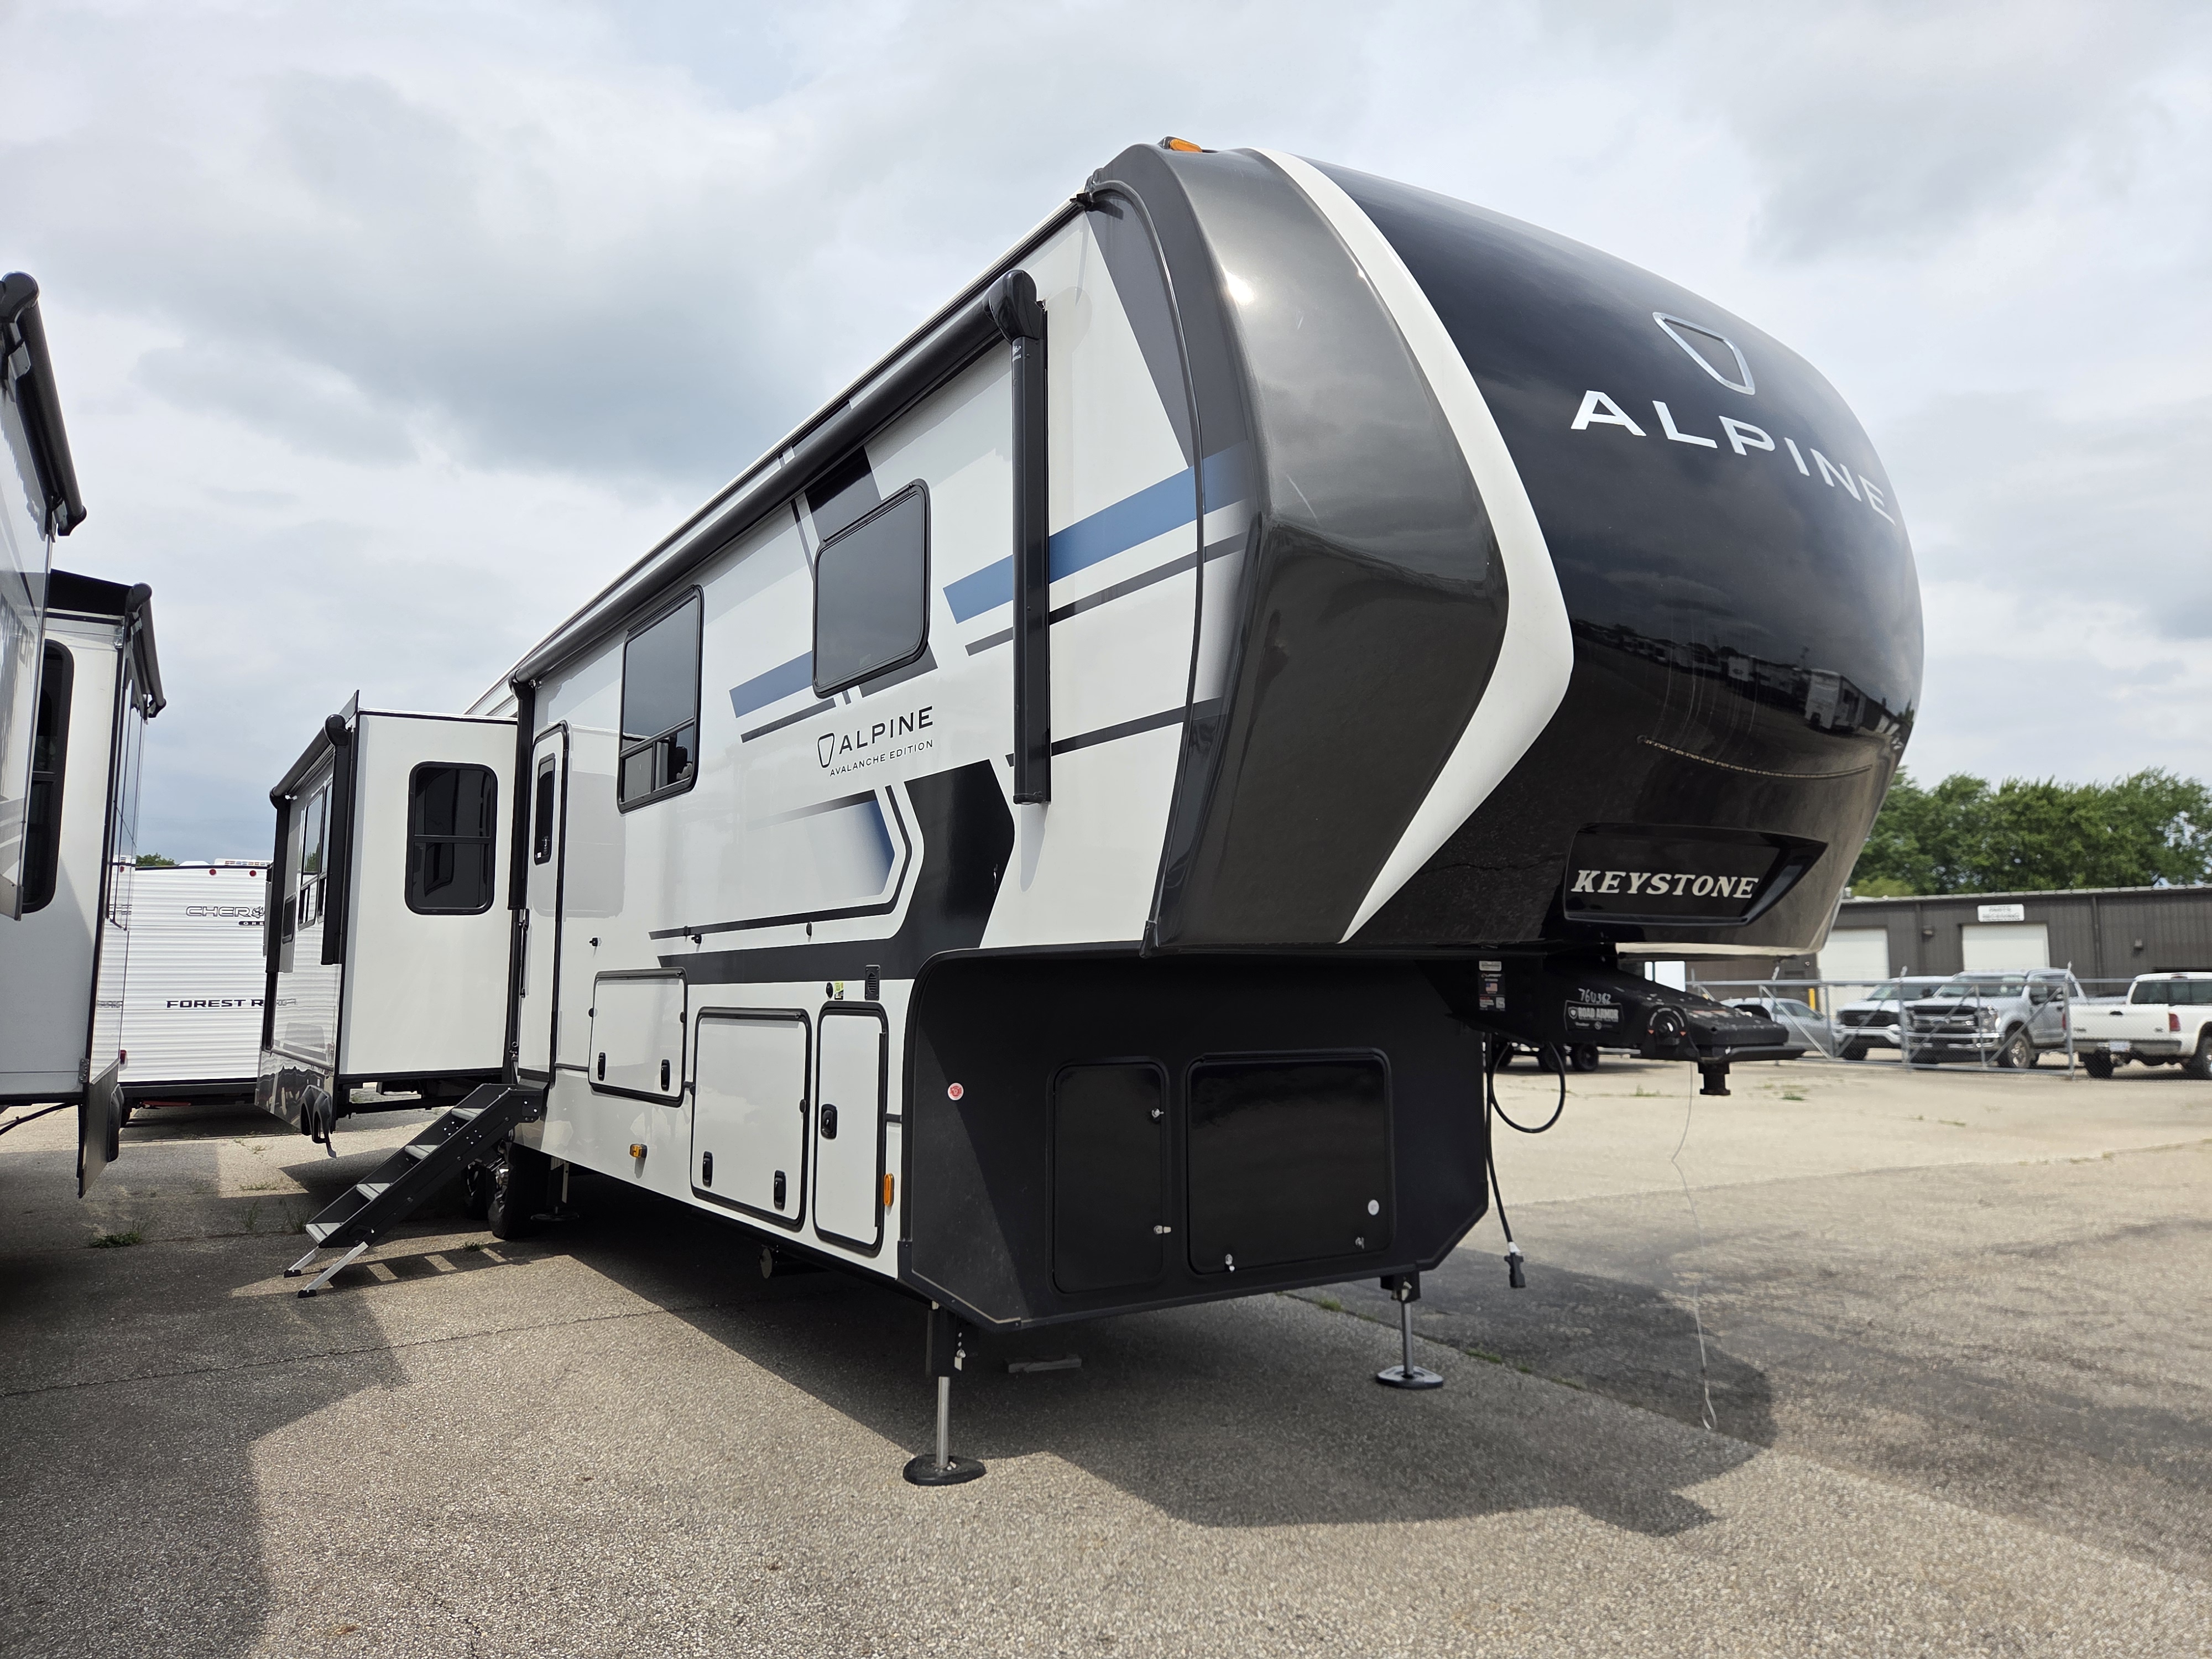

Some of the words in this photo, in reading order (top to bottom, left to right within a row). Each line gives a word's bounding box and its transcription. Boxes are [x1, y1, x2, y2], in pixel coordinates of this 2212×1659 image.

[1571, 390, 1896, 526] ALPINE
[839, 706, 933, 755] ALPINE
[830, 754, 886, 777] AVALANCHE
[889, 739, 933, 759] EDITION
[1571, 870, 1759, 899] KEYSTONE
[166, 999, 246, 1008] FOREST
